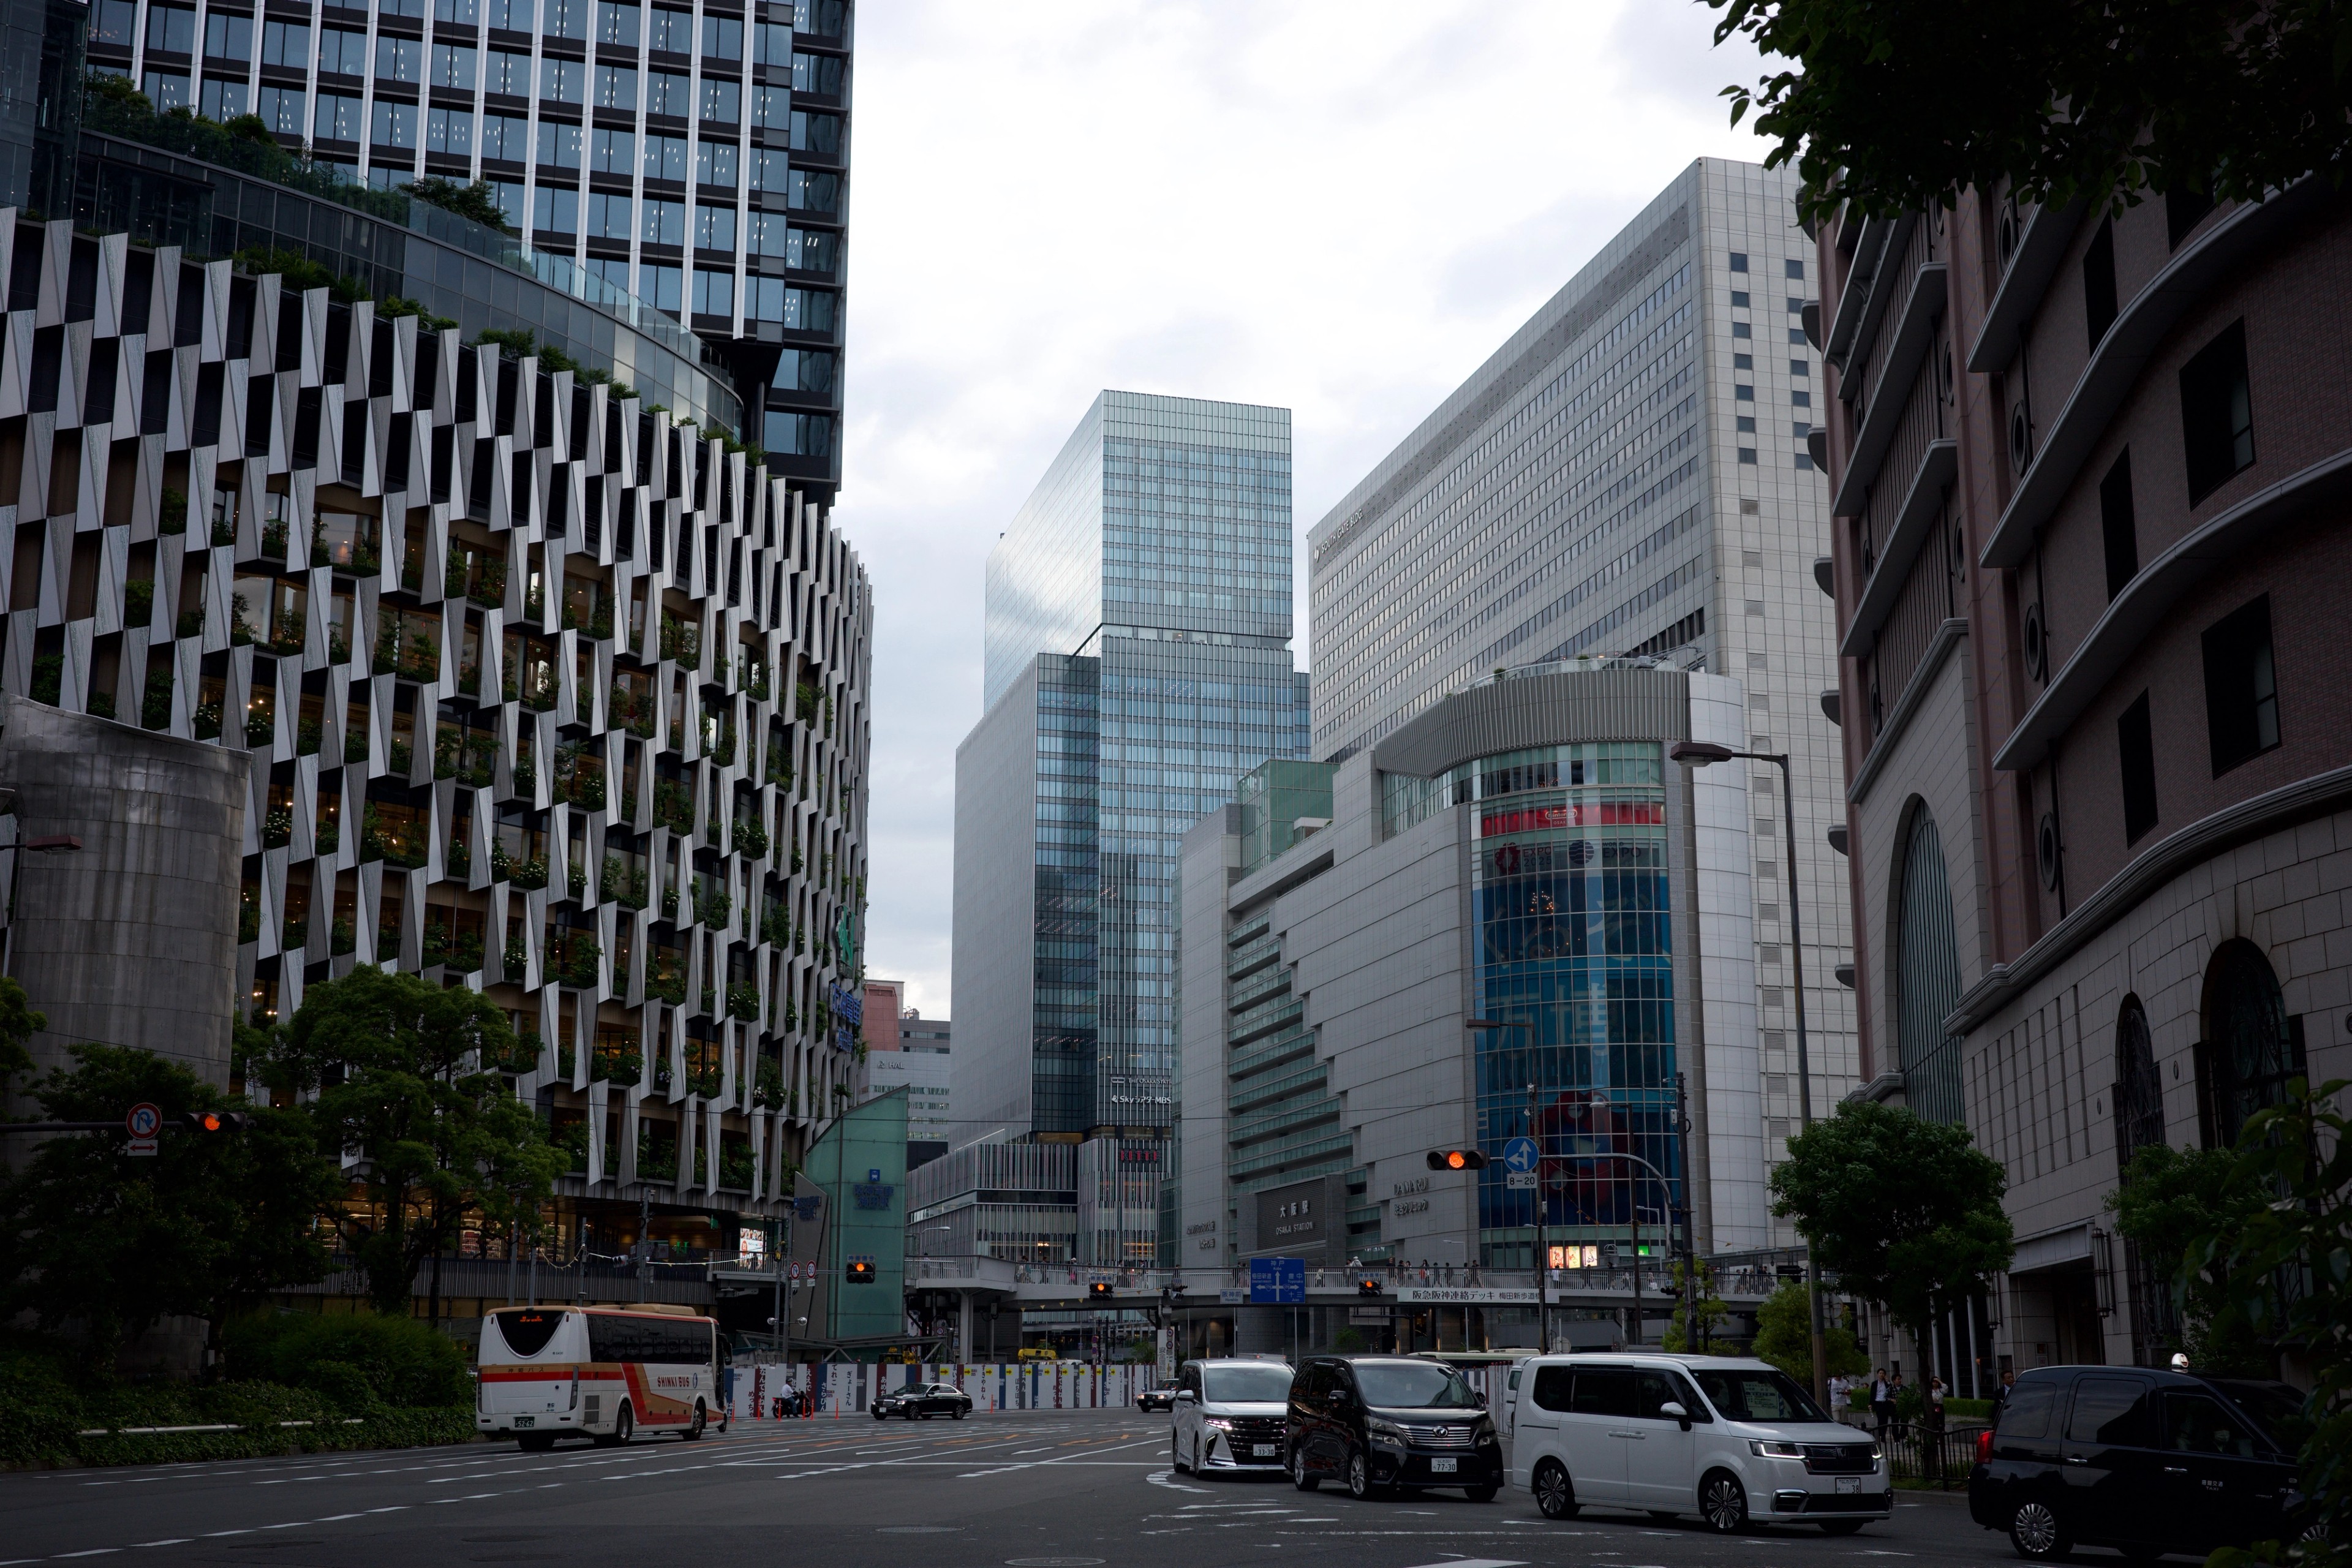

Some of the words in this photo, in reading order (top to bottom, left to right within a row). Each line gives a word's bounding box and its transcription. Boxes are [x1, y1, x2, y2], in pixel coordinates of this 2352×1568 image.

[1523, 846, 1551, 857] EXPO
[1603, 847, 1642, 858] EXPO
[1524, 856, 1552, 867] 2025
[1120, 1149, 1161, 1161] KITTE
[1280, 1200, 1310, 1218] 大阪駅
[1276, 1226, 1292, 1235] OSAKA
[1294, 1221, 1313, 1232] STATION
[809, 1265, 815, 1274] 50
[1412, 1289, 1495, 1300] 阪急阪神連絡デッキ
[657, 1376, 677, 1387] SHINKI
[678, 1376, 690, 1387] BUS
